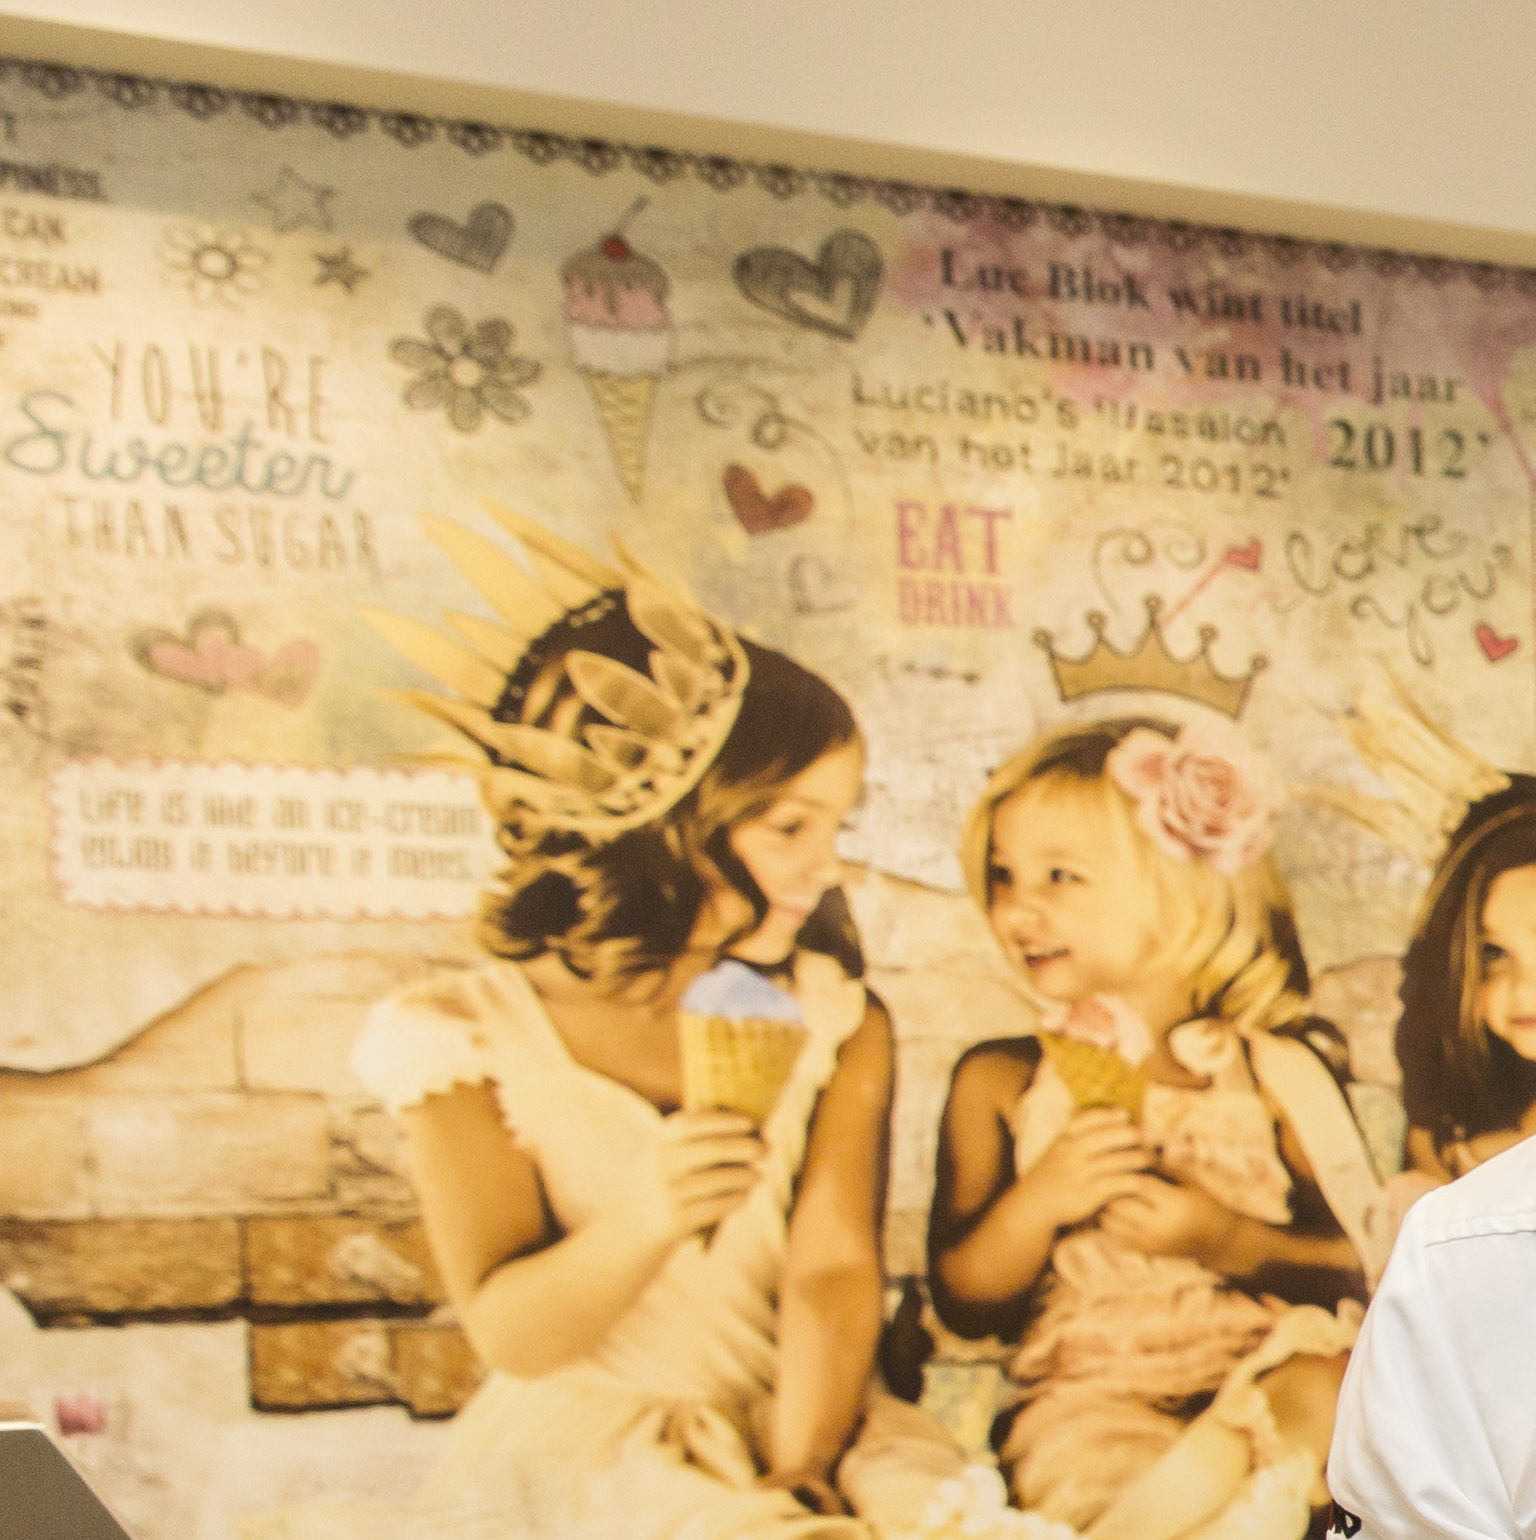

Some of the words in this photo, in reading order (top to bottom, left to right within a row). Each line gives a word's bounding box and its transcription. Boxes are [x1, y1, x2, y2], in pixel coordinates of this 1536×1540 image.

[936, 246, 1026, 296] Luc
[1048, 262, 1149, 310] Blok
[1167, 284, 1266, 325] wint
[1172, 342, 1263, 384] van
[1279, 346, 1353, 394] het
[1368, 356, 1464, 407] jaar
[2, 388, 355, 500] Sweeter
[853, 427, 941, 464] van
[959, 434, 1032, 474] het
[62, 497, 192, 562] THAN
[211, 502, 382, 578] SUGAR
[895, 500, 1013, 575] EAT
[897, 575, 1014, 630] DRINK
